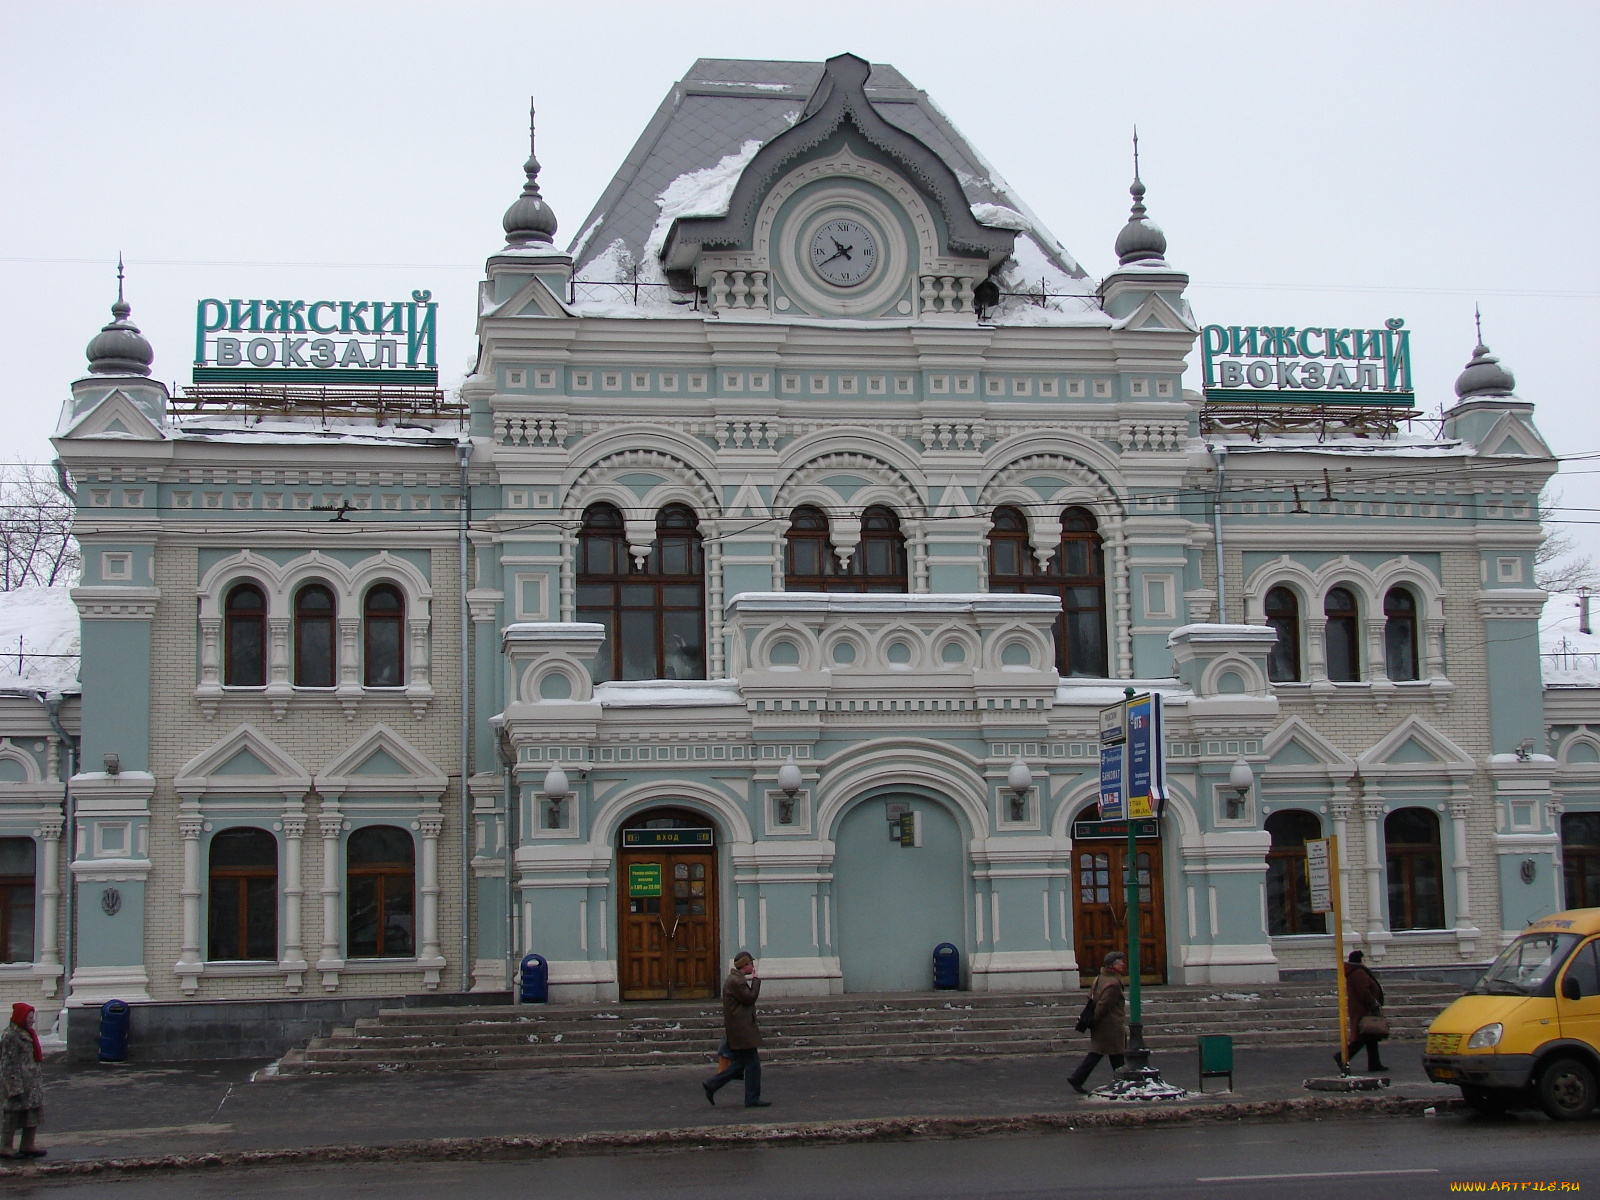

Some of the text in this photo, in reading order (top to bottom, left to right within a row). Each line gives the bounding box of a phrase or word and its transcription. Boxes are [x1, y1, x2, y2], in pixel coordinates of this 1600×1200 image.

[194, 289, 438, 368] РИЖСКИЙ
[217, 337, 397, 368] ВОКЗАЛ
[1202, 318, 1413, 391] РИЖСКИЙ
[1220, 360, 1378, 389] ВОКЗАЛ
